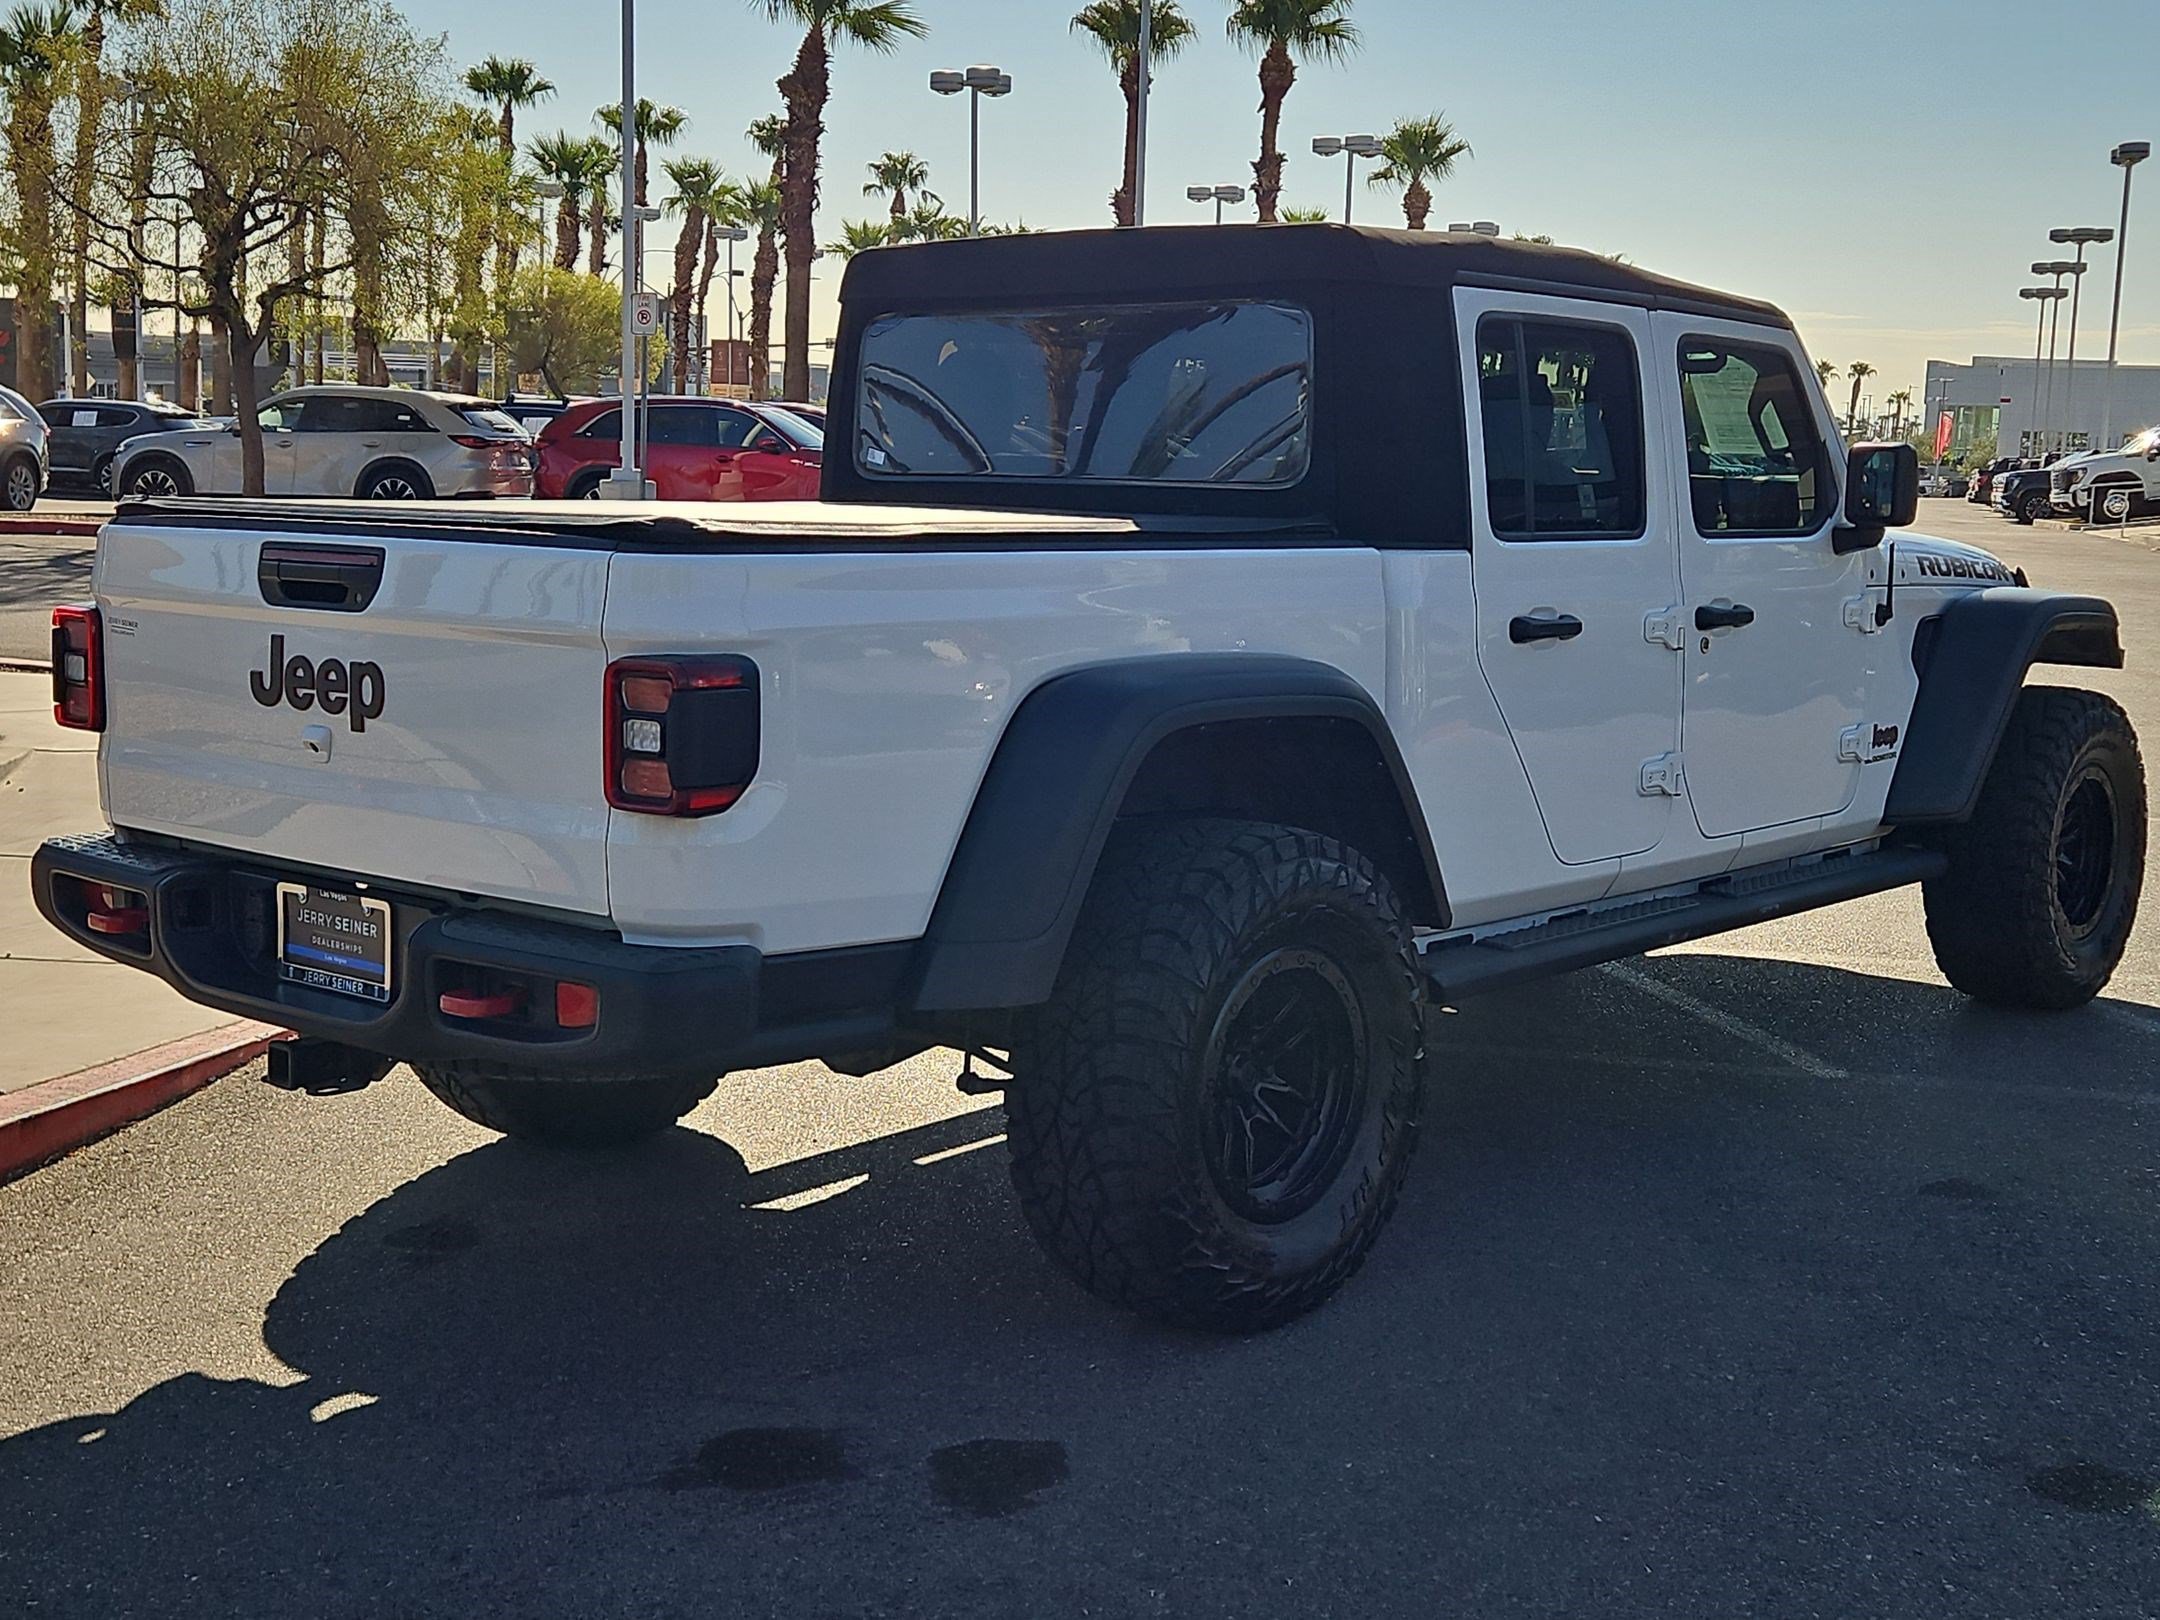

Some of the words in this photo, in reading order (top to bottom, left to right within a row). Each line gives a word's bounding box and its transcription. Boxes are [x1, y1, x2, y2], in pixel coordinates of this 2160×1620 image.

[1916, 555, 2010, 582] RUBICON
[250, 633, 386, 734] Jeep
[297, 908, 333, 928] JERRY
[334, 916, 378, 938] SEINER
[311, 935, 363, 955] DEALERSHIPS
[303, 970, 331, 983] JERRY
[331, 976, 364, 994] SEINER
